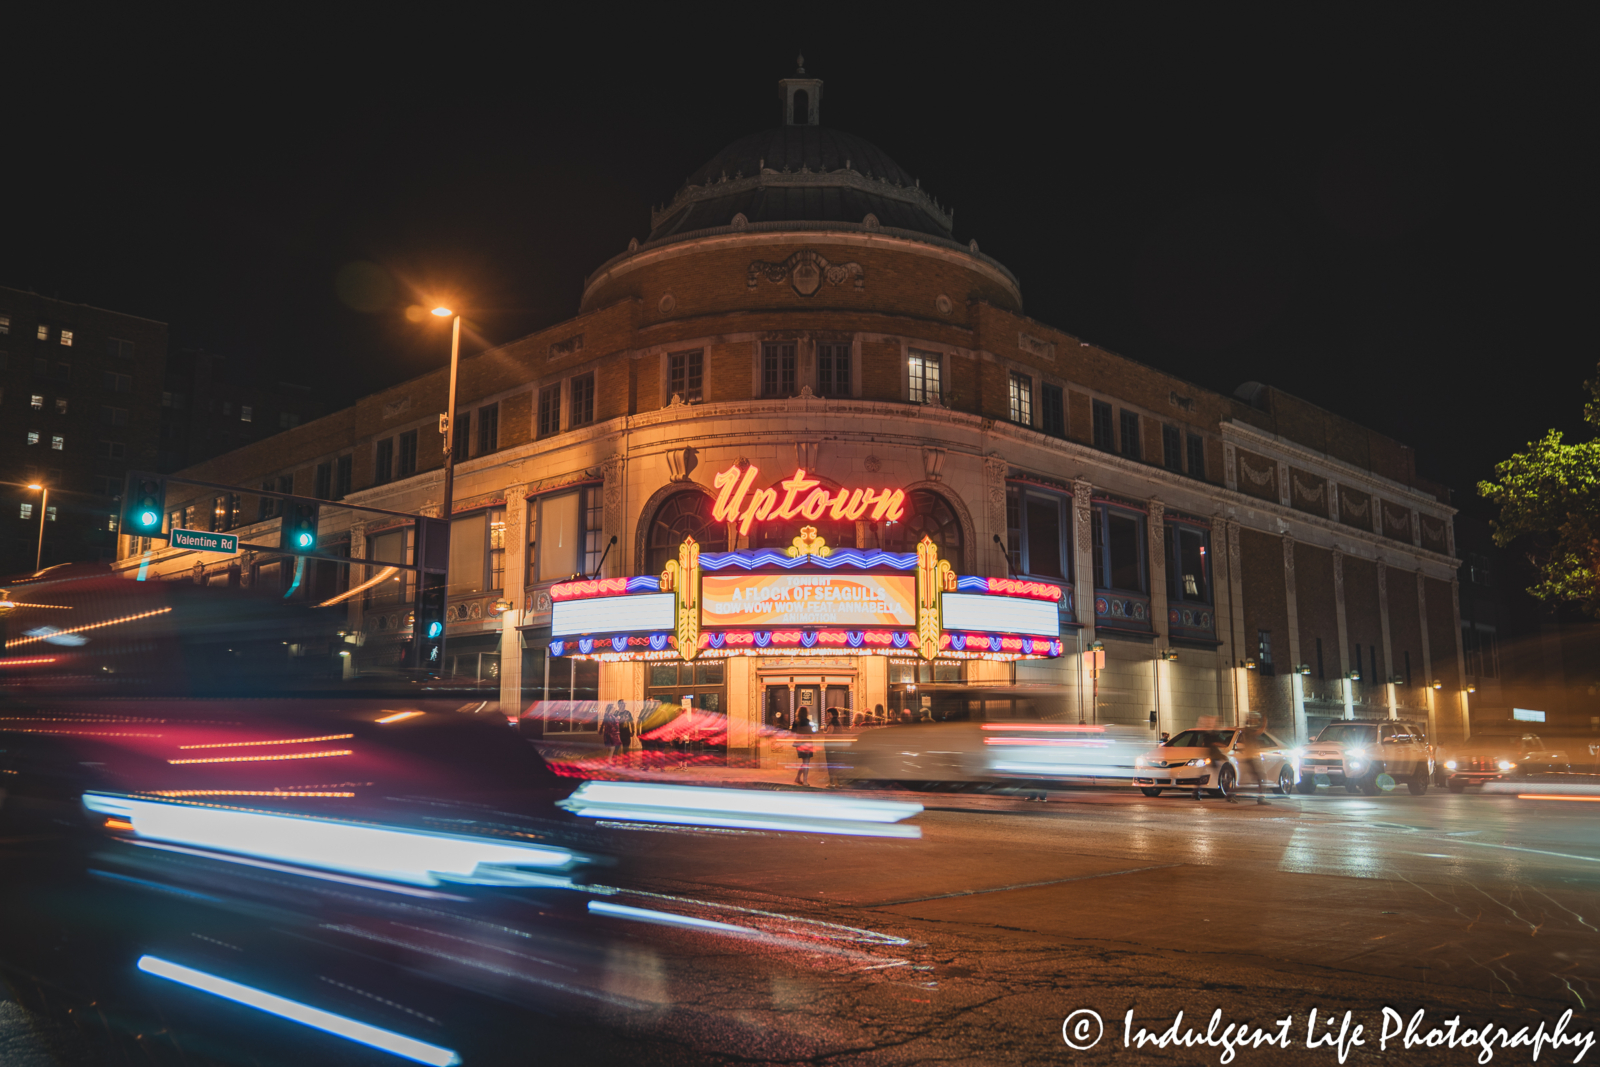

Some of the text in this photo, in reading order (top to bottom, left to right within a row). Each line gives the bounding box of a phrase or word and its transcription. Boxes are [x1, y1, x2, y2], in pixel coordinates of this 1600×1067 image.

[711, 464, 906, 537] Uptown
[176, 534, 232, 549] Valentine Rd
[787, 577, 832, 586] TONIGHT
[732, 587, 886, 600] A FLOCK OF SEAGULLS
[715, 602, 903, 614] BOW WOW WOW FEAT. ANNABELLA
